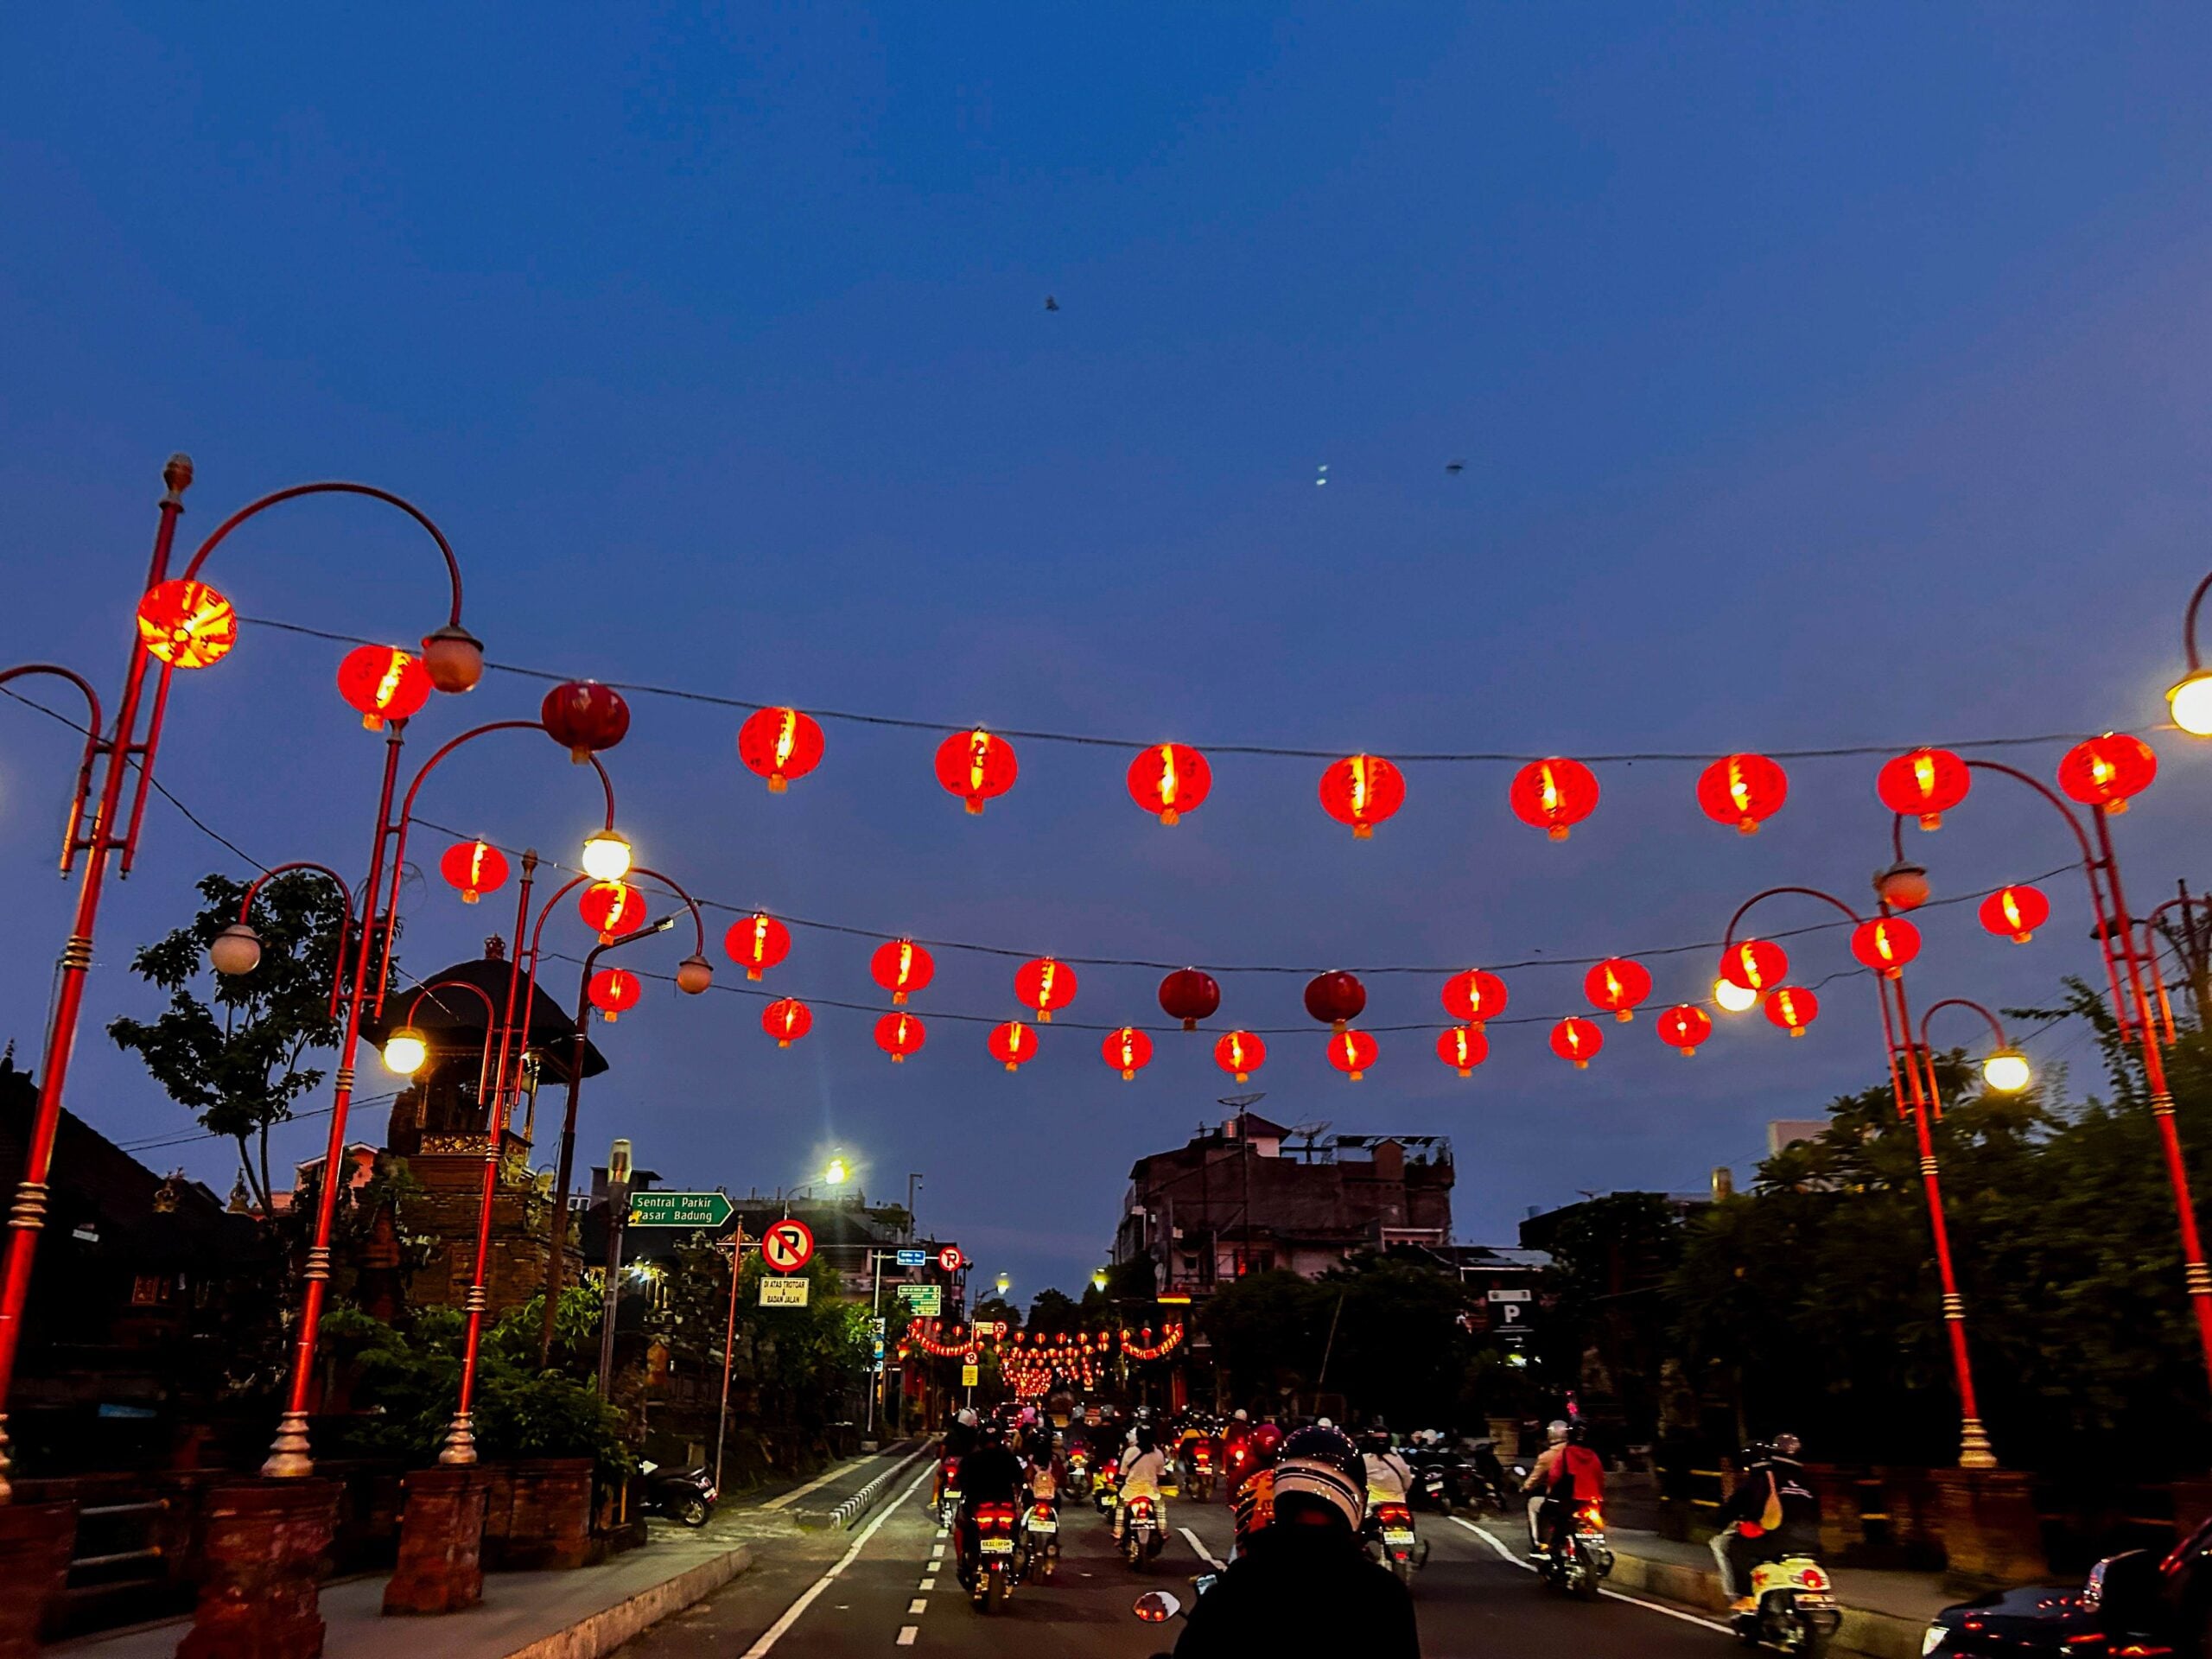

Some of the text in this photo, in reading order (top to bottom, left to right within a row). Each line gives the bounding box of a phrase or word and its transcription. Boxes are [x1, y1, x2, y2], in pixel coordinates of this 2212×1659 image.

[637, 1197, 712, 1207] Sentral Parkir
[637, 1211, 712, 1223] Pasar Badung
[1503, 1305, 1520, 1323] P
